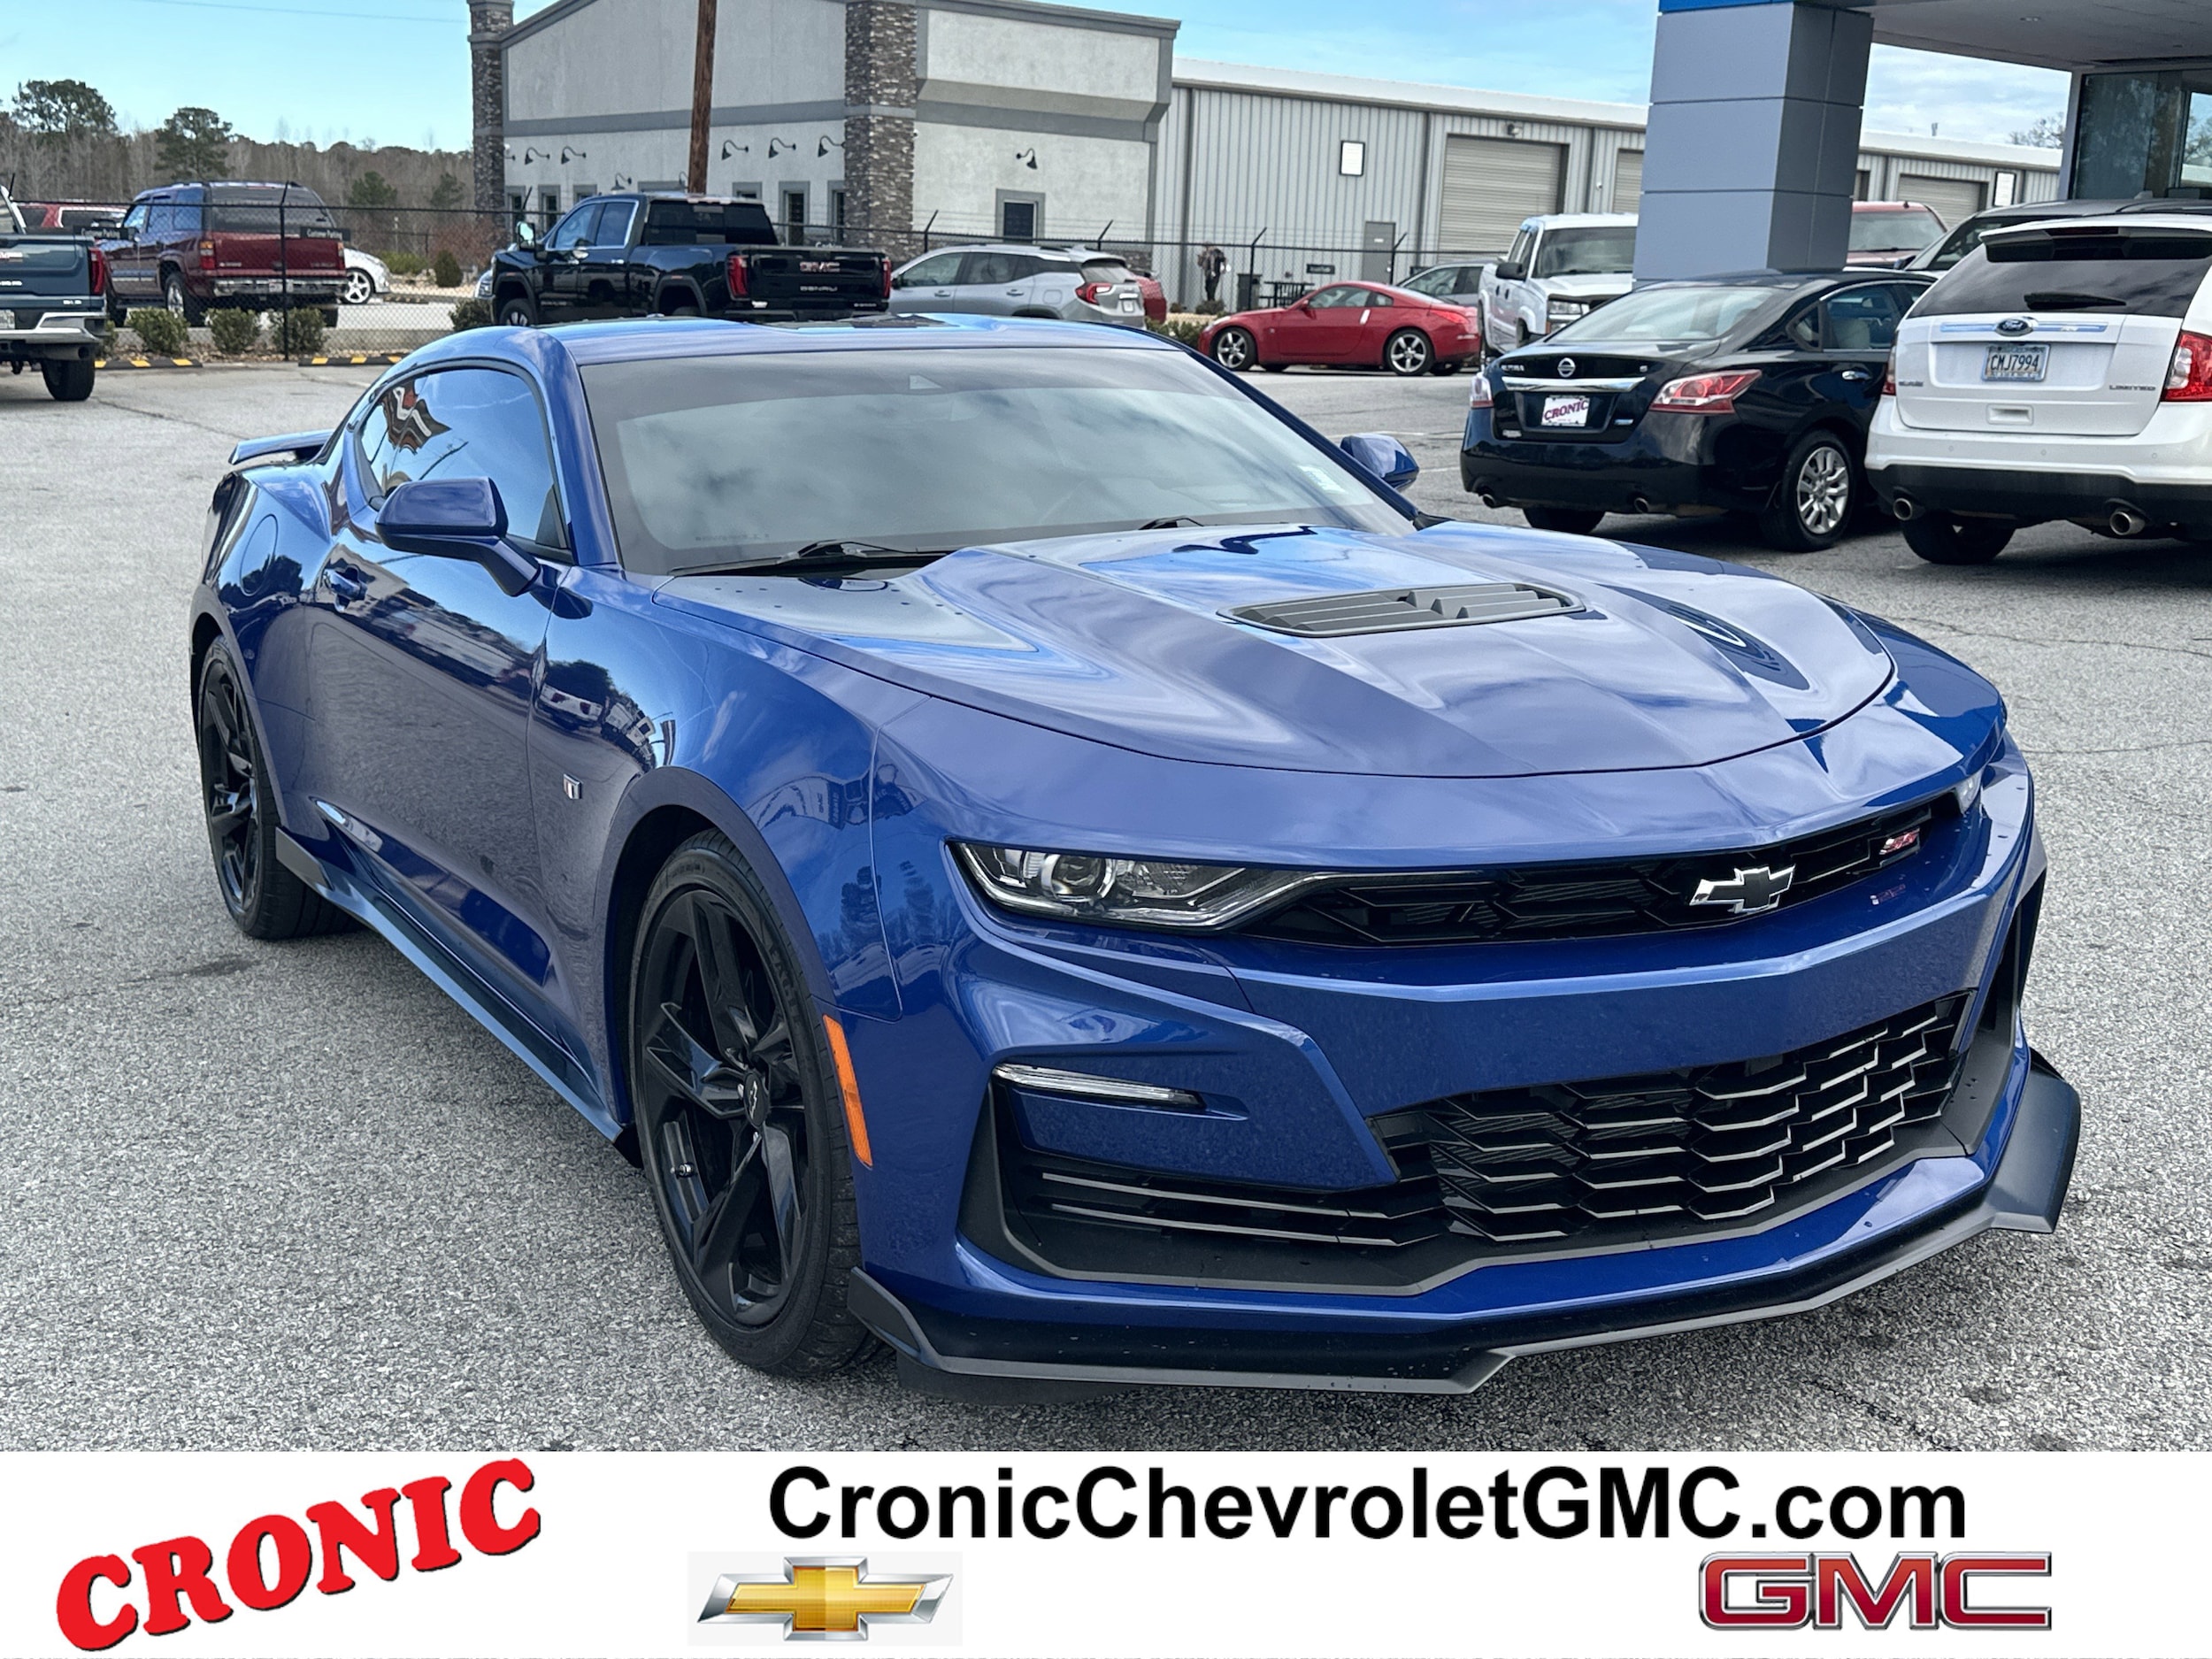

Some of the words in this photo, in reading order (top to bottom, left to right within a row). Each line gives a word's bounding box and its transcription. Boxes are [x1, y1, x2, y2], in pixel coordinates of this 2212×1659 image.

[800, 261, 841, 273] GMC
[1990, 355, 2039, 372] CMJ7994
[1543, 400, 1589, 421] CRONIC
